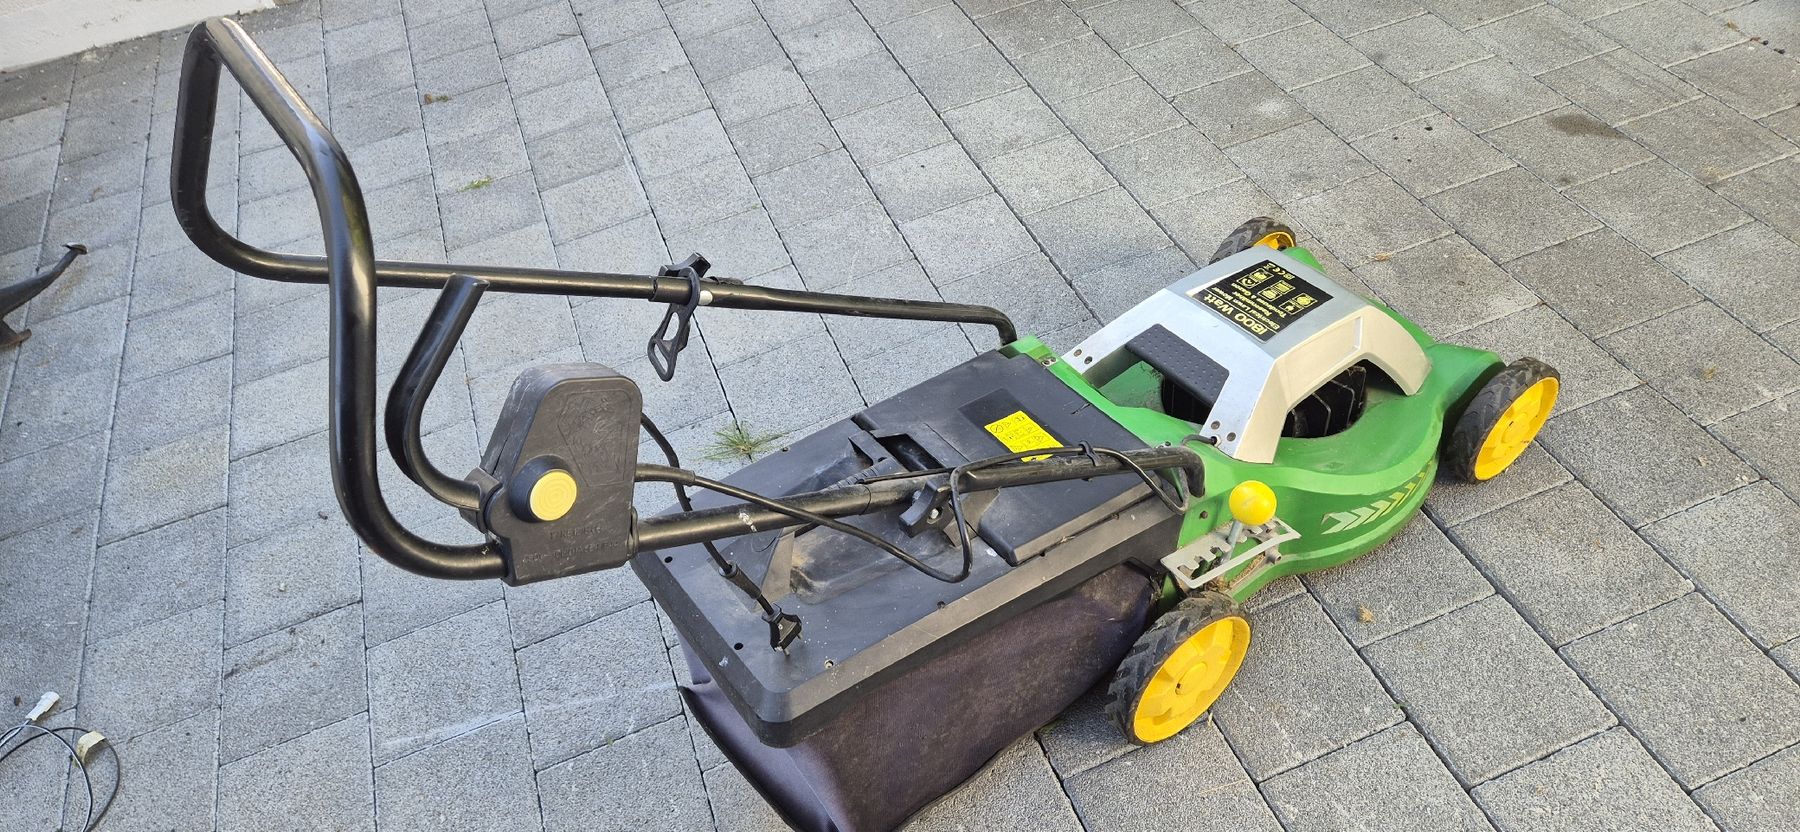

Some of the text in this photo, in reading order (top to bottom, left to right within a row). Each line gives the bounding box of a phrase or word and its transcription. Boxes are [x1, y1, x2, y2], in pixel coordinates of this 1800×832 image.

[1231, 283, 1251, 296] Gazon
[1204, 294, 1268, 335] 1800 Watt
[1211, 287, 1280, 330] Electrical Lawn Mower
[1256, 298, 1287, 318] Tondeuse
